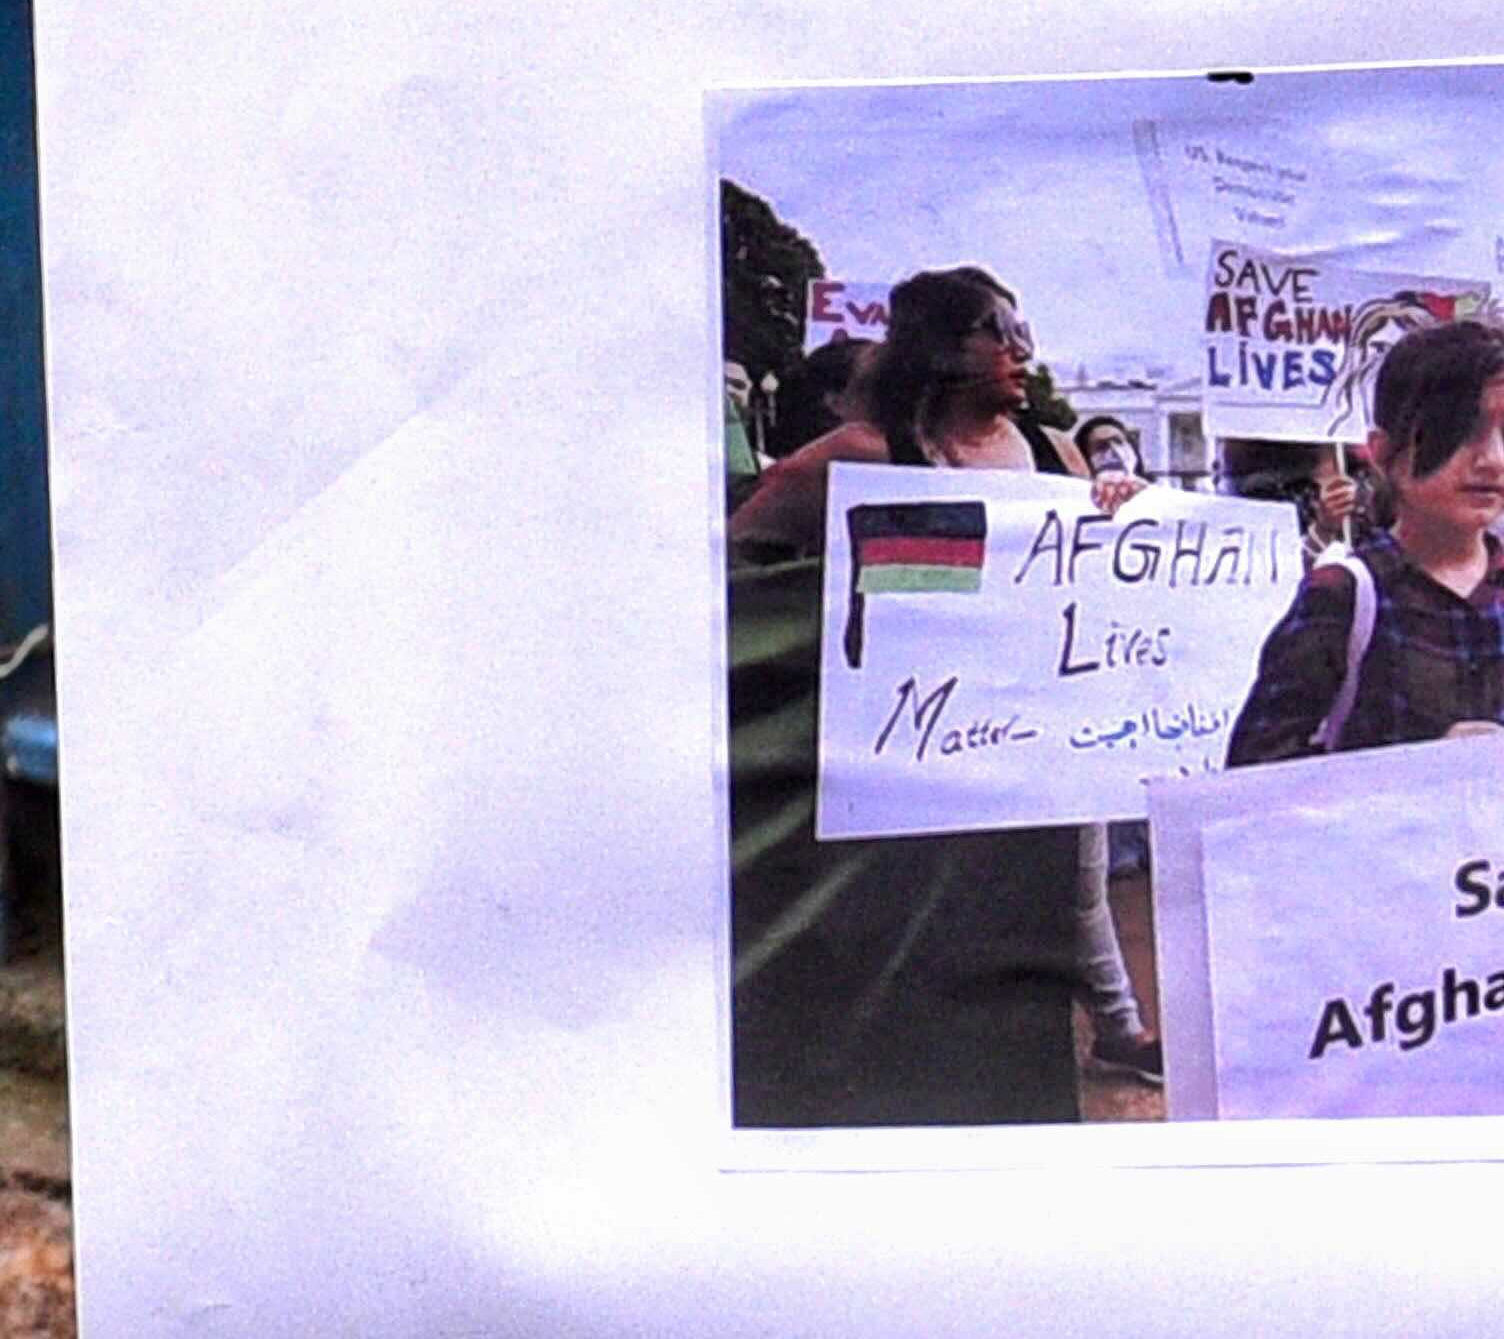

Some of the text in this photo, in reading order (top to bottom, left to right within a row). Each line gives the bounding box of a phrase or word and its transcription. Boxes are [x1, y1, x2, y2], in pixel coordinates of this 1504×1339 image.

[1214, 249, 1321, 303] SAVE
[1205, 291, 1354, 345] AFGHAN
[1206, 339, 1337, 390] LIVES
